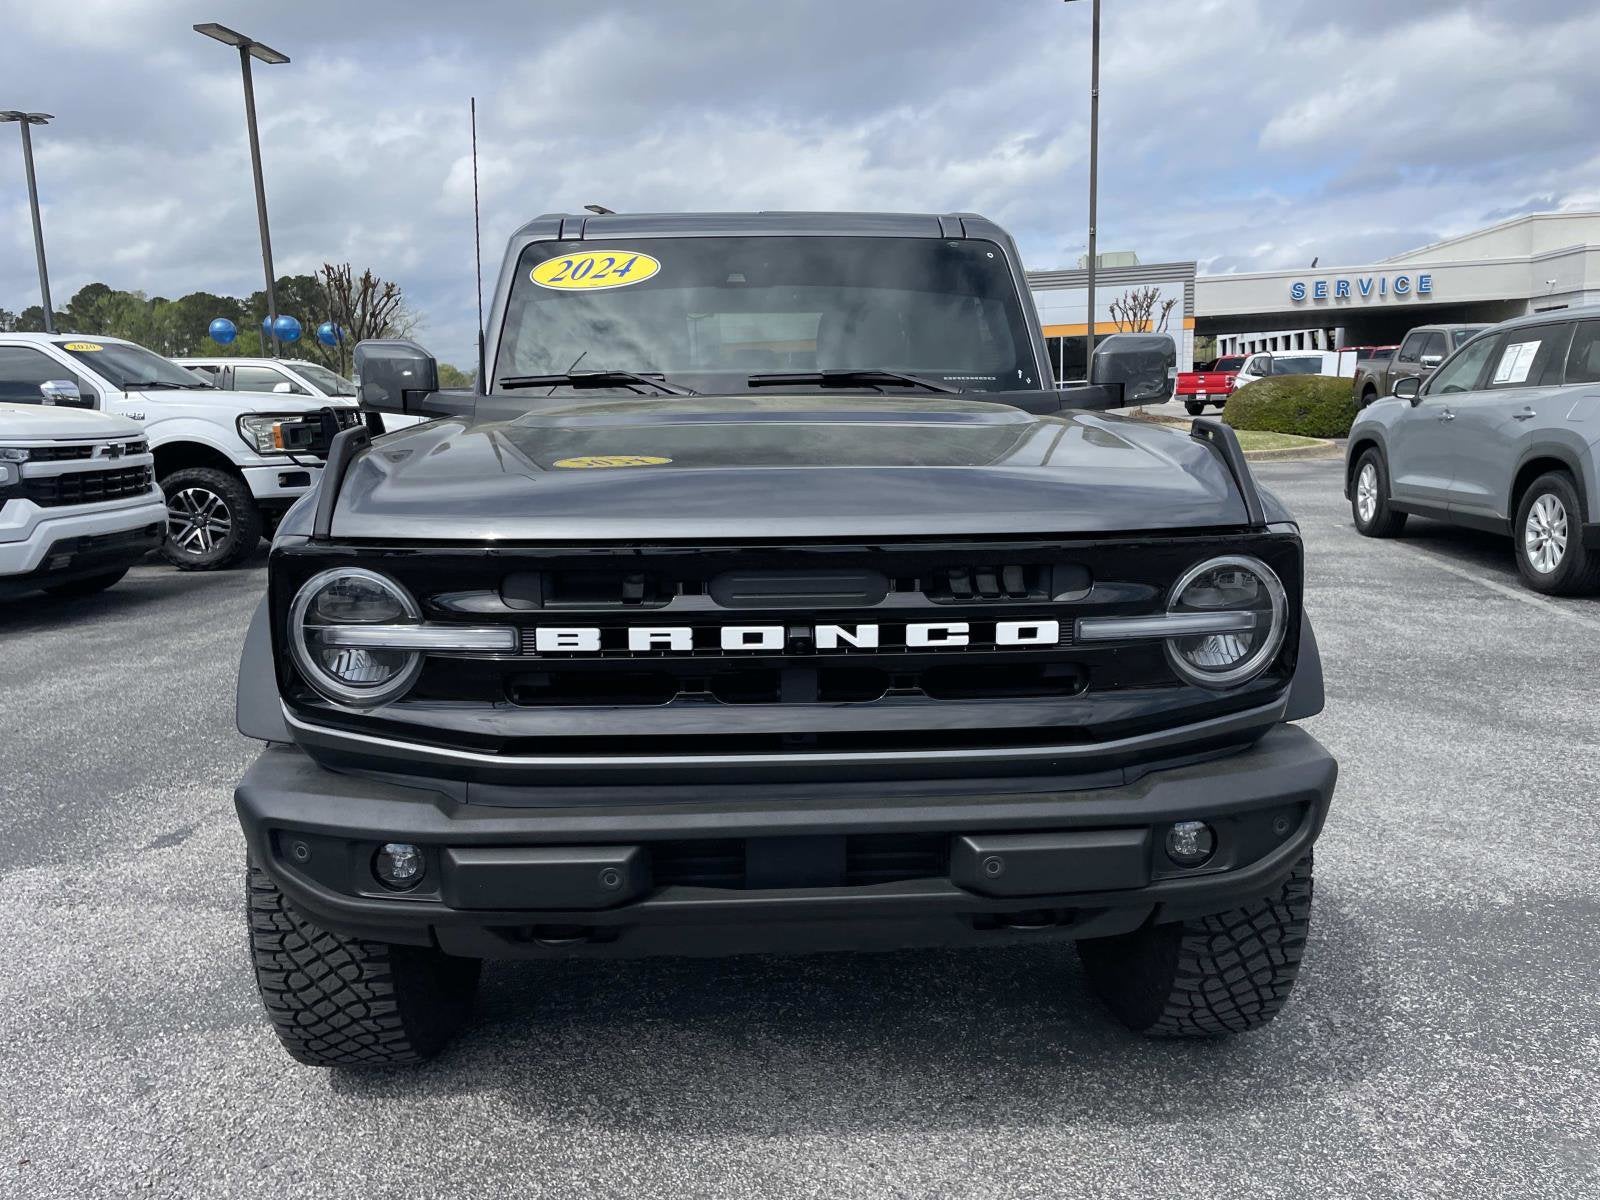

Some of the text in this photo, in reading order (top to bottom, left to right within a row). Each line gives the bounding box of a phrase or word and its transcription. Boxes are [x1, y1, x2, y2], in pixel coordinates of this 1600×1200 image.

[547, 255, 639, 282] 2024
[1290, 274, 1433, 300] SERVICE
[535, 620, 1059, 651] BRONCO
